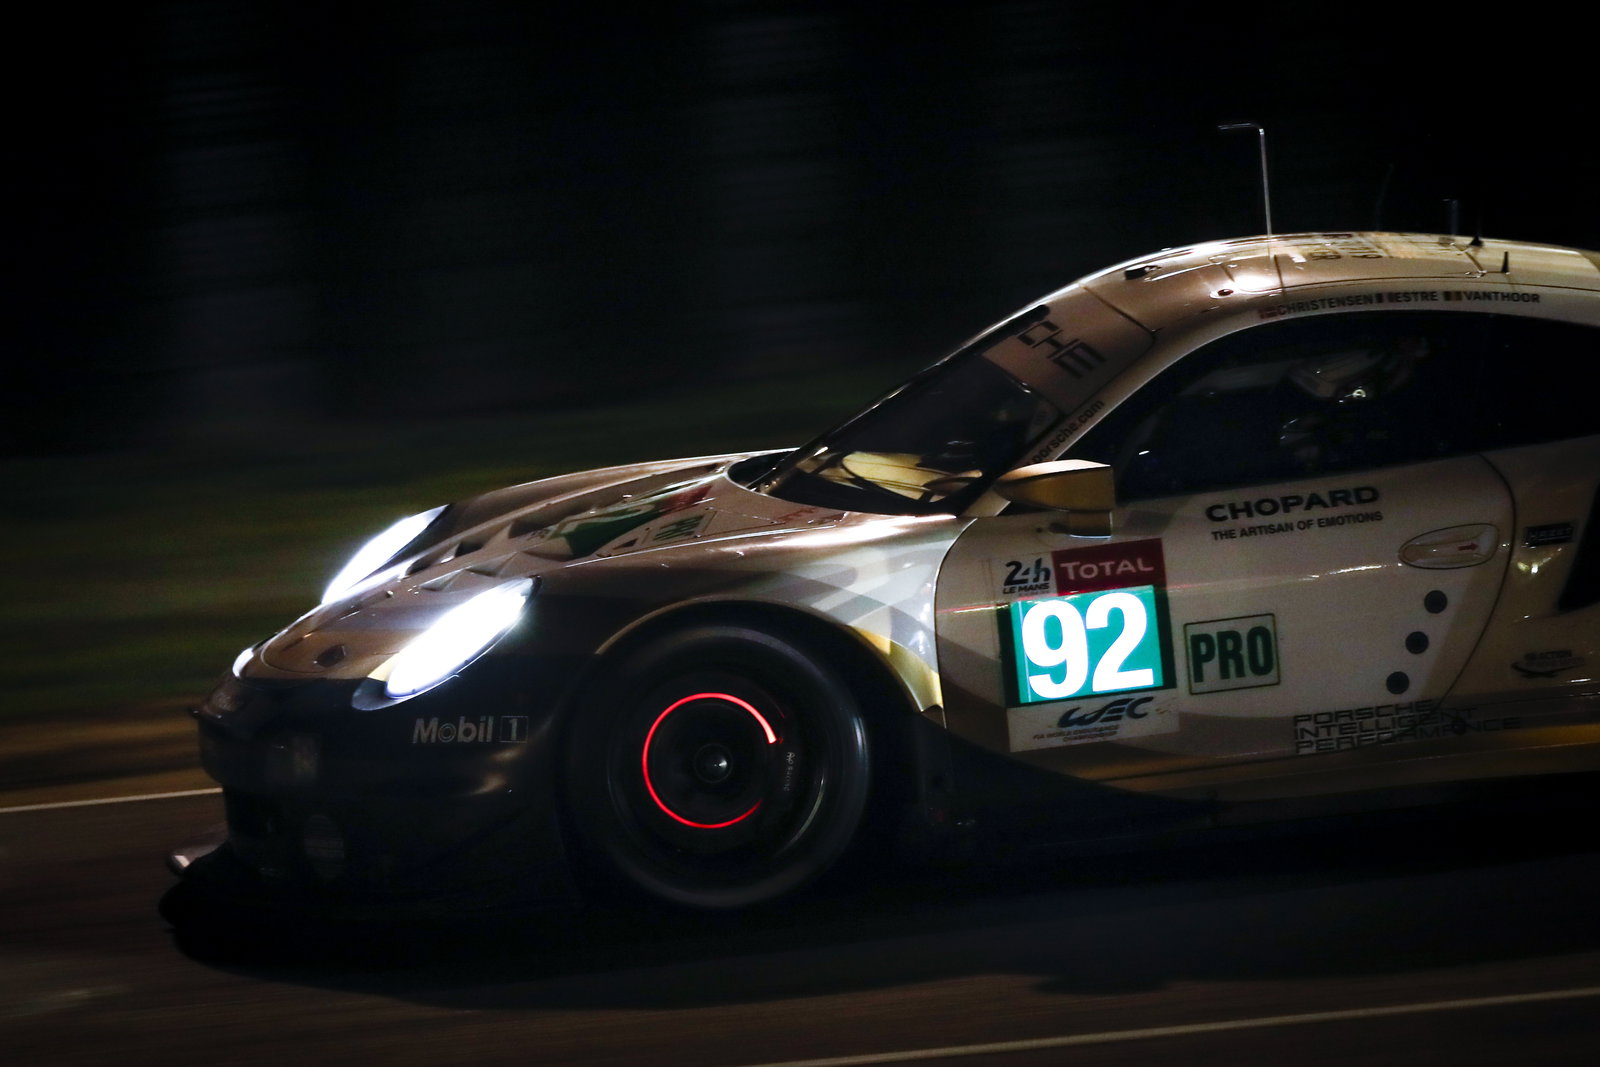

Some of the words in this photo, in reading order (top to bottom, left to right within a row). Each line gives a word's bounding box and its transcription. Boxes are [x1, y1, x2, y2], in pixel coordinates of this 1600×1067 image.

[1278, 293, 1373, 316] CHRISTENSEN
[1463, 291, 1540, 303] VANTHOOR
[1205, 486, 1379, 522] CHOPARD
[1211, 529, 1237, 541] THE
[1239, 523, 1294, 538] ARTISAN
[1297, 519, 1314, 531] OF
[1317, 511, 1383, 528] EMOTIONS
[1060, 557, 1154, 581] TOTAL
[1021, 592, 1155, 699] 92
[1190, 625, 1274, 683] PRO
[1057, 696, 1154, 728] WEC
[1294, 700, 1434, 727] PORSCHE
[412, 715, 495, 744] Mobil
